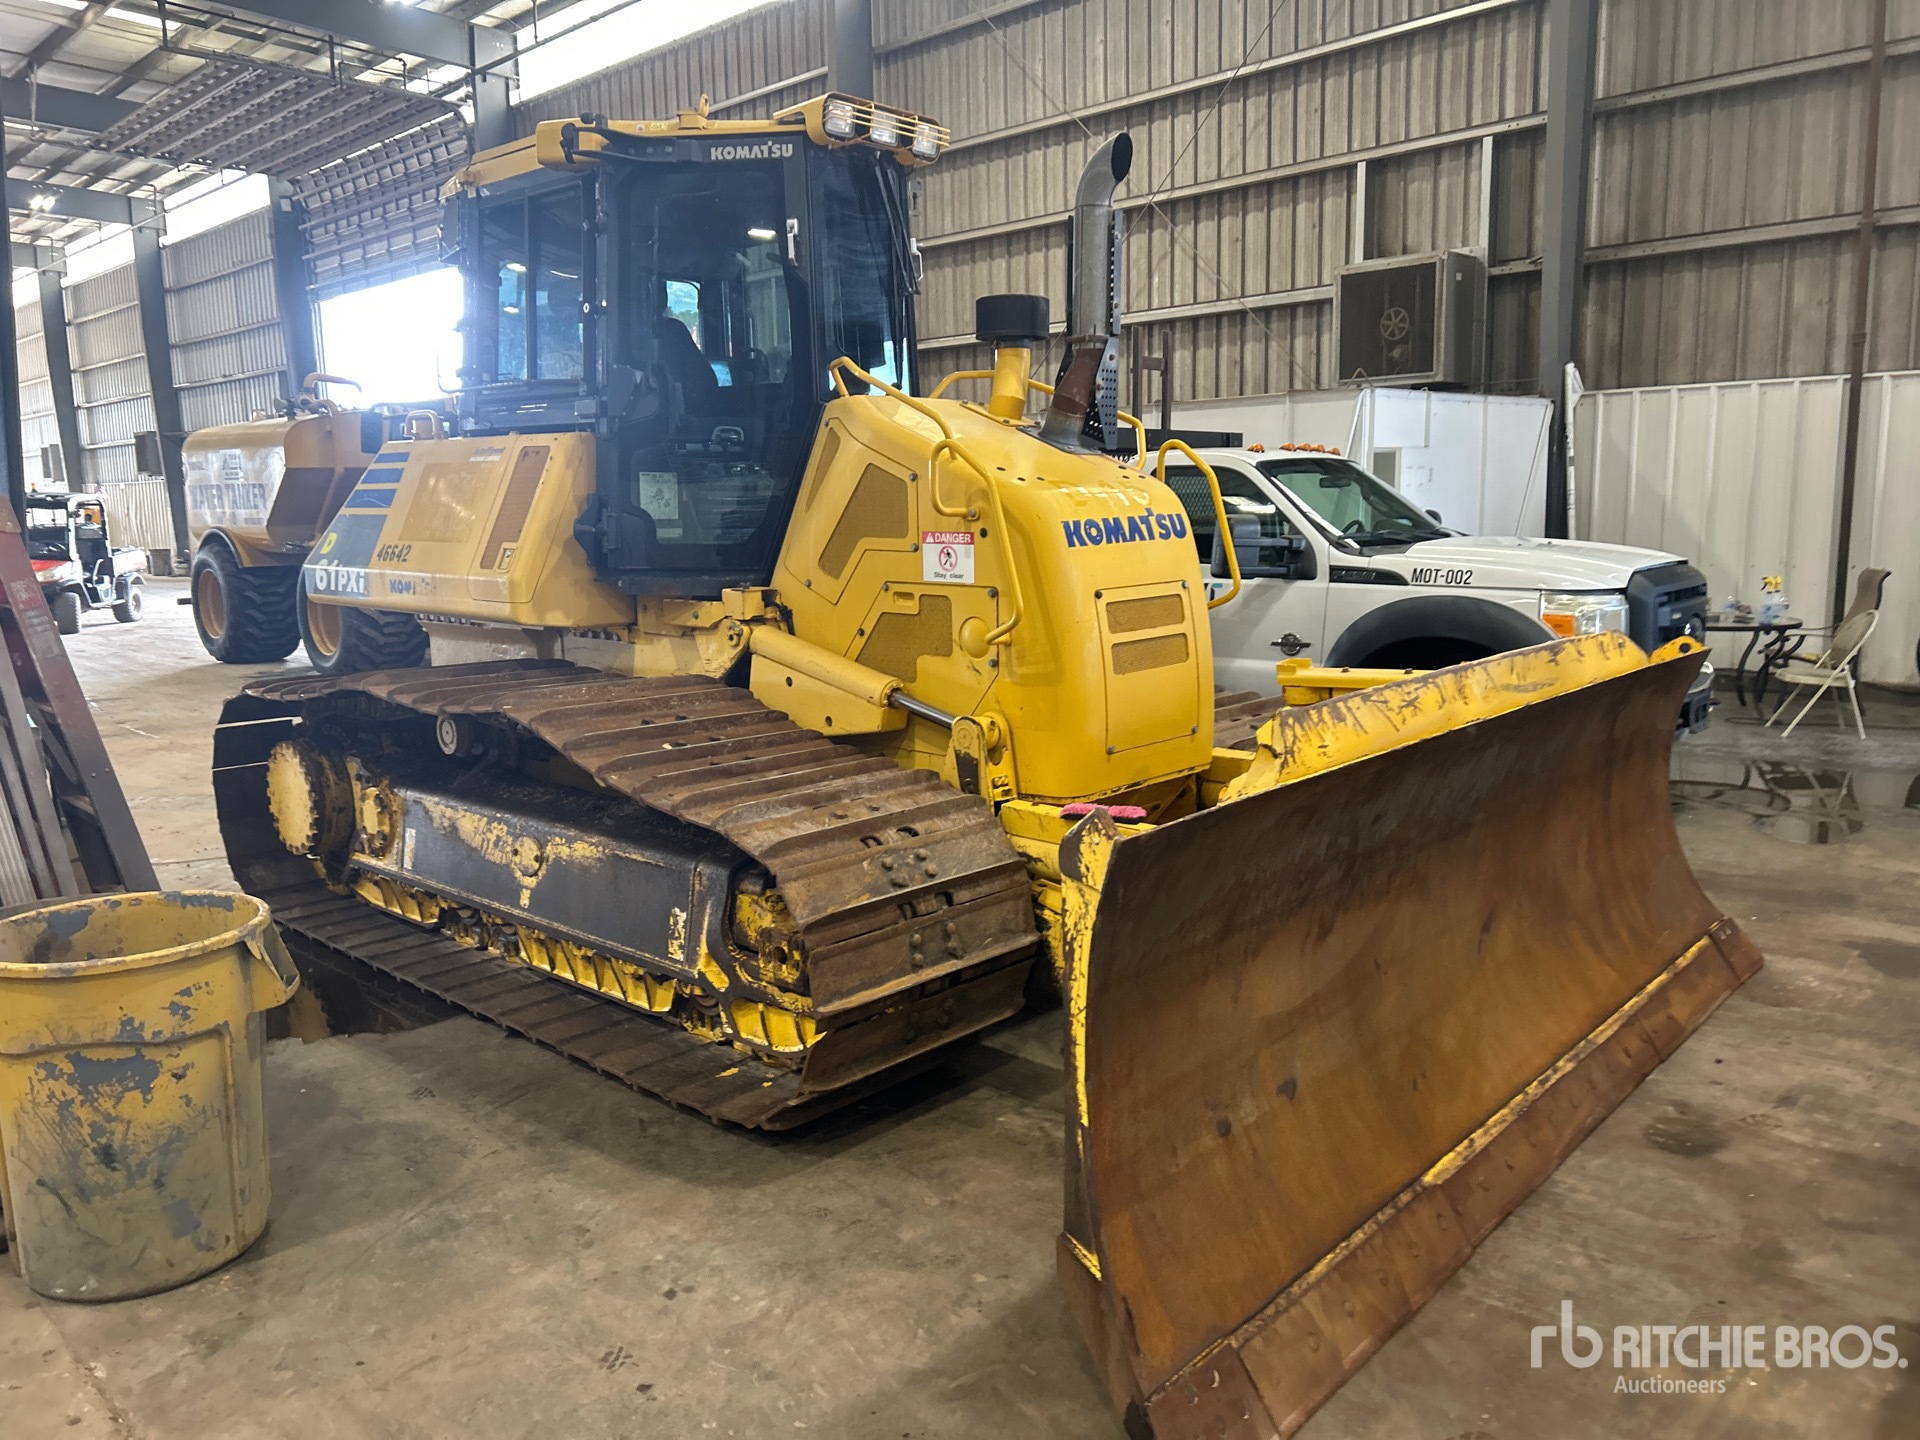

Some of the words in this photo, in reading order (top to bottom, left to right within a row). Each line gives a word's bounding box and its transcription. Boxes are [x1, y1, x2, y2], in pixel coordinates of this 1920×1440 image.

[711, 141, 793, 160] KOMATSU
[1062, 507, 1187, 548] KOMATSU
[934, 533, 971, 543] DANGER
[376, 544, 412, 562] 46642
[315, 558, 365, 593] 61PXi
[934, 571, 947, 579] Stay
[1411, 567, 1473, 585] MOT-002
